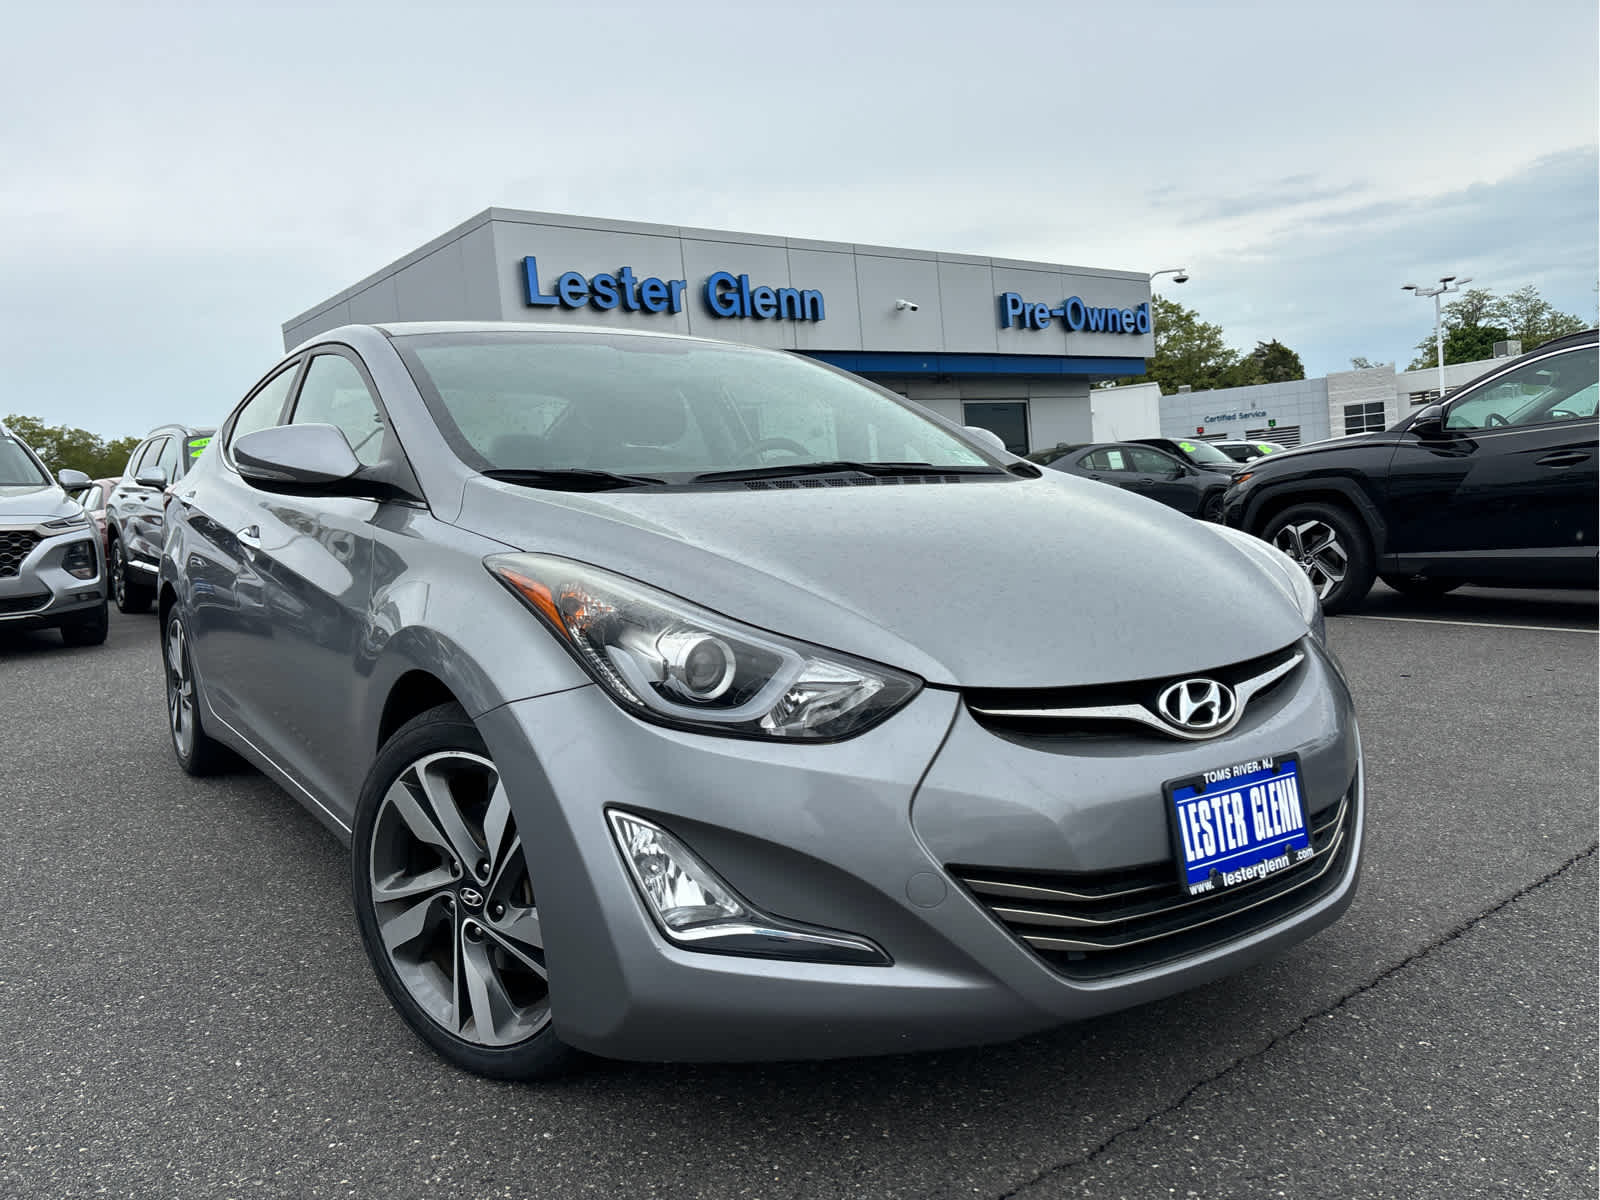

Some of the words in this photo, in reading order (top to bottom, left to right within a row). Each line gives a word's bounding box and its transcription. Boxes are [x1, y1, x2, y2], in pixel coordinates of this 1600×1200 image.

[522, 256, 687, 313] Lester
[703, 271, 825, 321] Glenn
[1001, 292, 1150, 334] Pre-Owned
[1204, 413, 1236, 423] Certified
[1239, 411, 1266, 419] Service
[1203, 768, 1232, 784] TOMS
[1262, 757, 1274, 770] NJ
[1178, 792, 1248, 862] LESTER
[1250, 776, 1303, 841] GLENN
[1189, 881, 1215, 896] www.
[1222, 855, 1290, 887] lesterglenn
